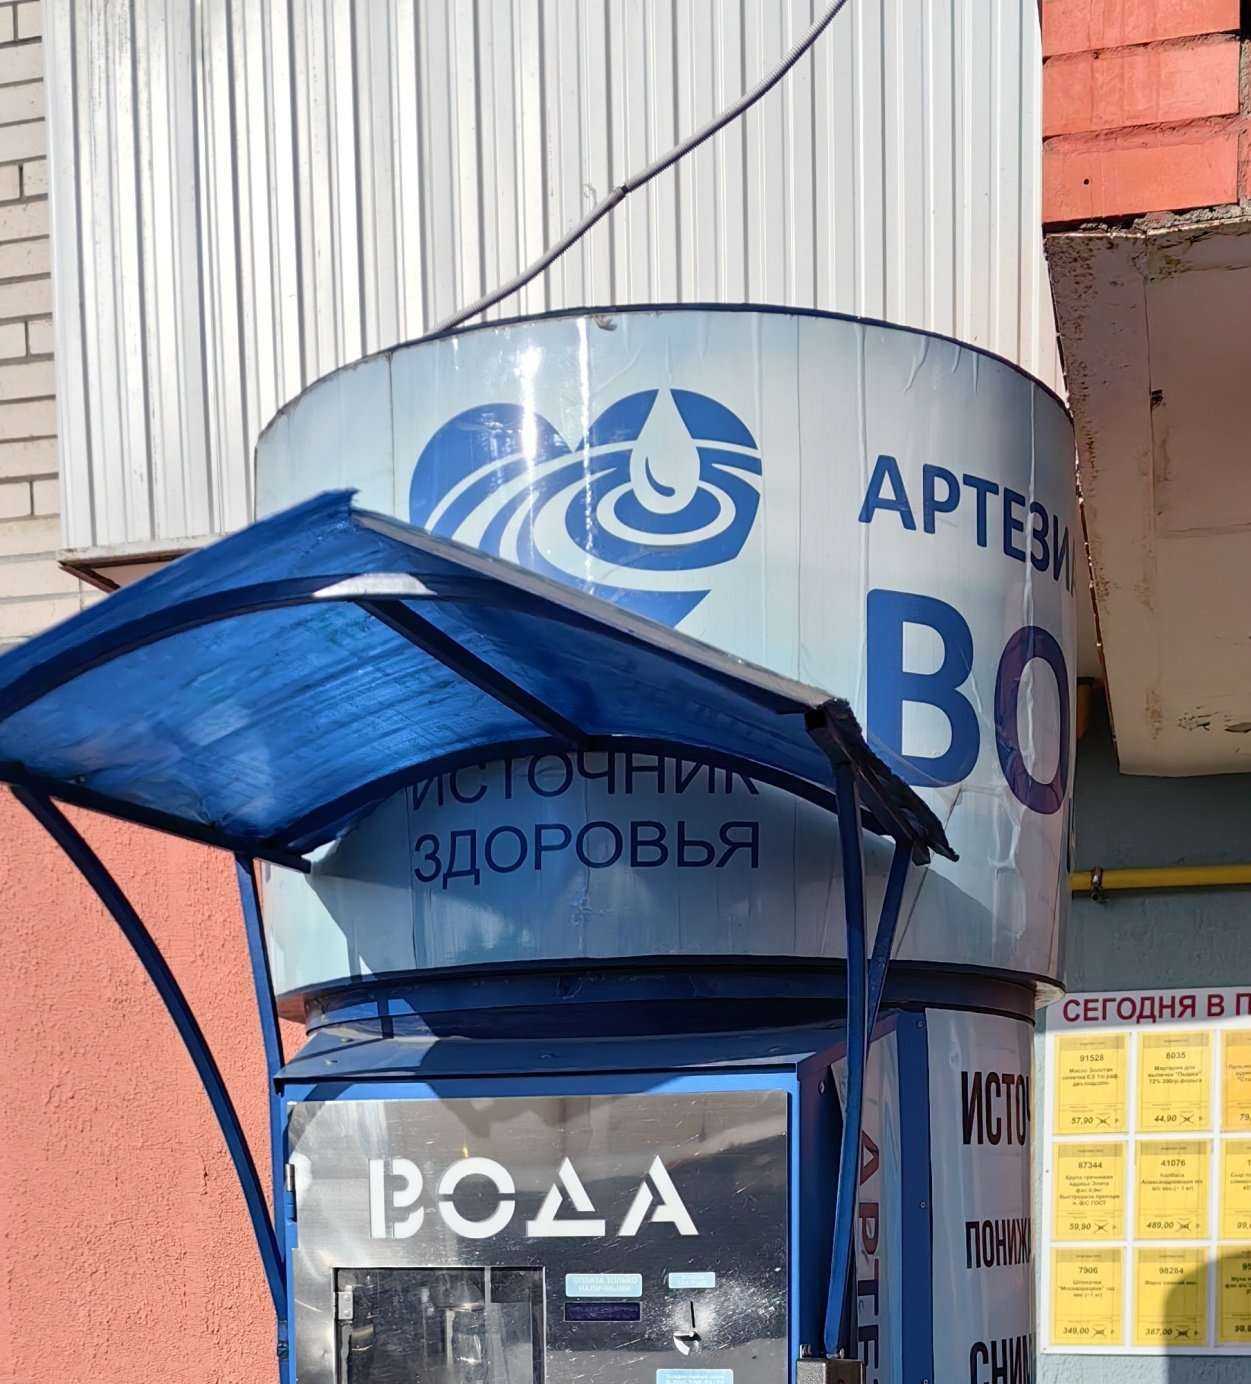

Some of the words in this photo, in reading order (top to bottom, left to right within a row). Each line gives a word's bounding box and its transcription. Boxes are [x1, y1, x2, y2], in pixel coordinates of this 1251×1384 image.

[858, 454, 1075, 597] АРТЕЗИ
[866, 588, 1070, 815] ВО
[413, 820, 760, 890] ЗДОРОВЬЯ
[1063, 995, 1197, 1024] СЕГОДНЯ
[1207, 994, 1225, 1017] В
[369, 1154, 699, 1239] ВОДА
